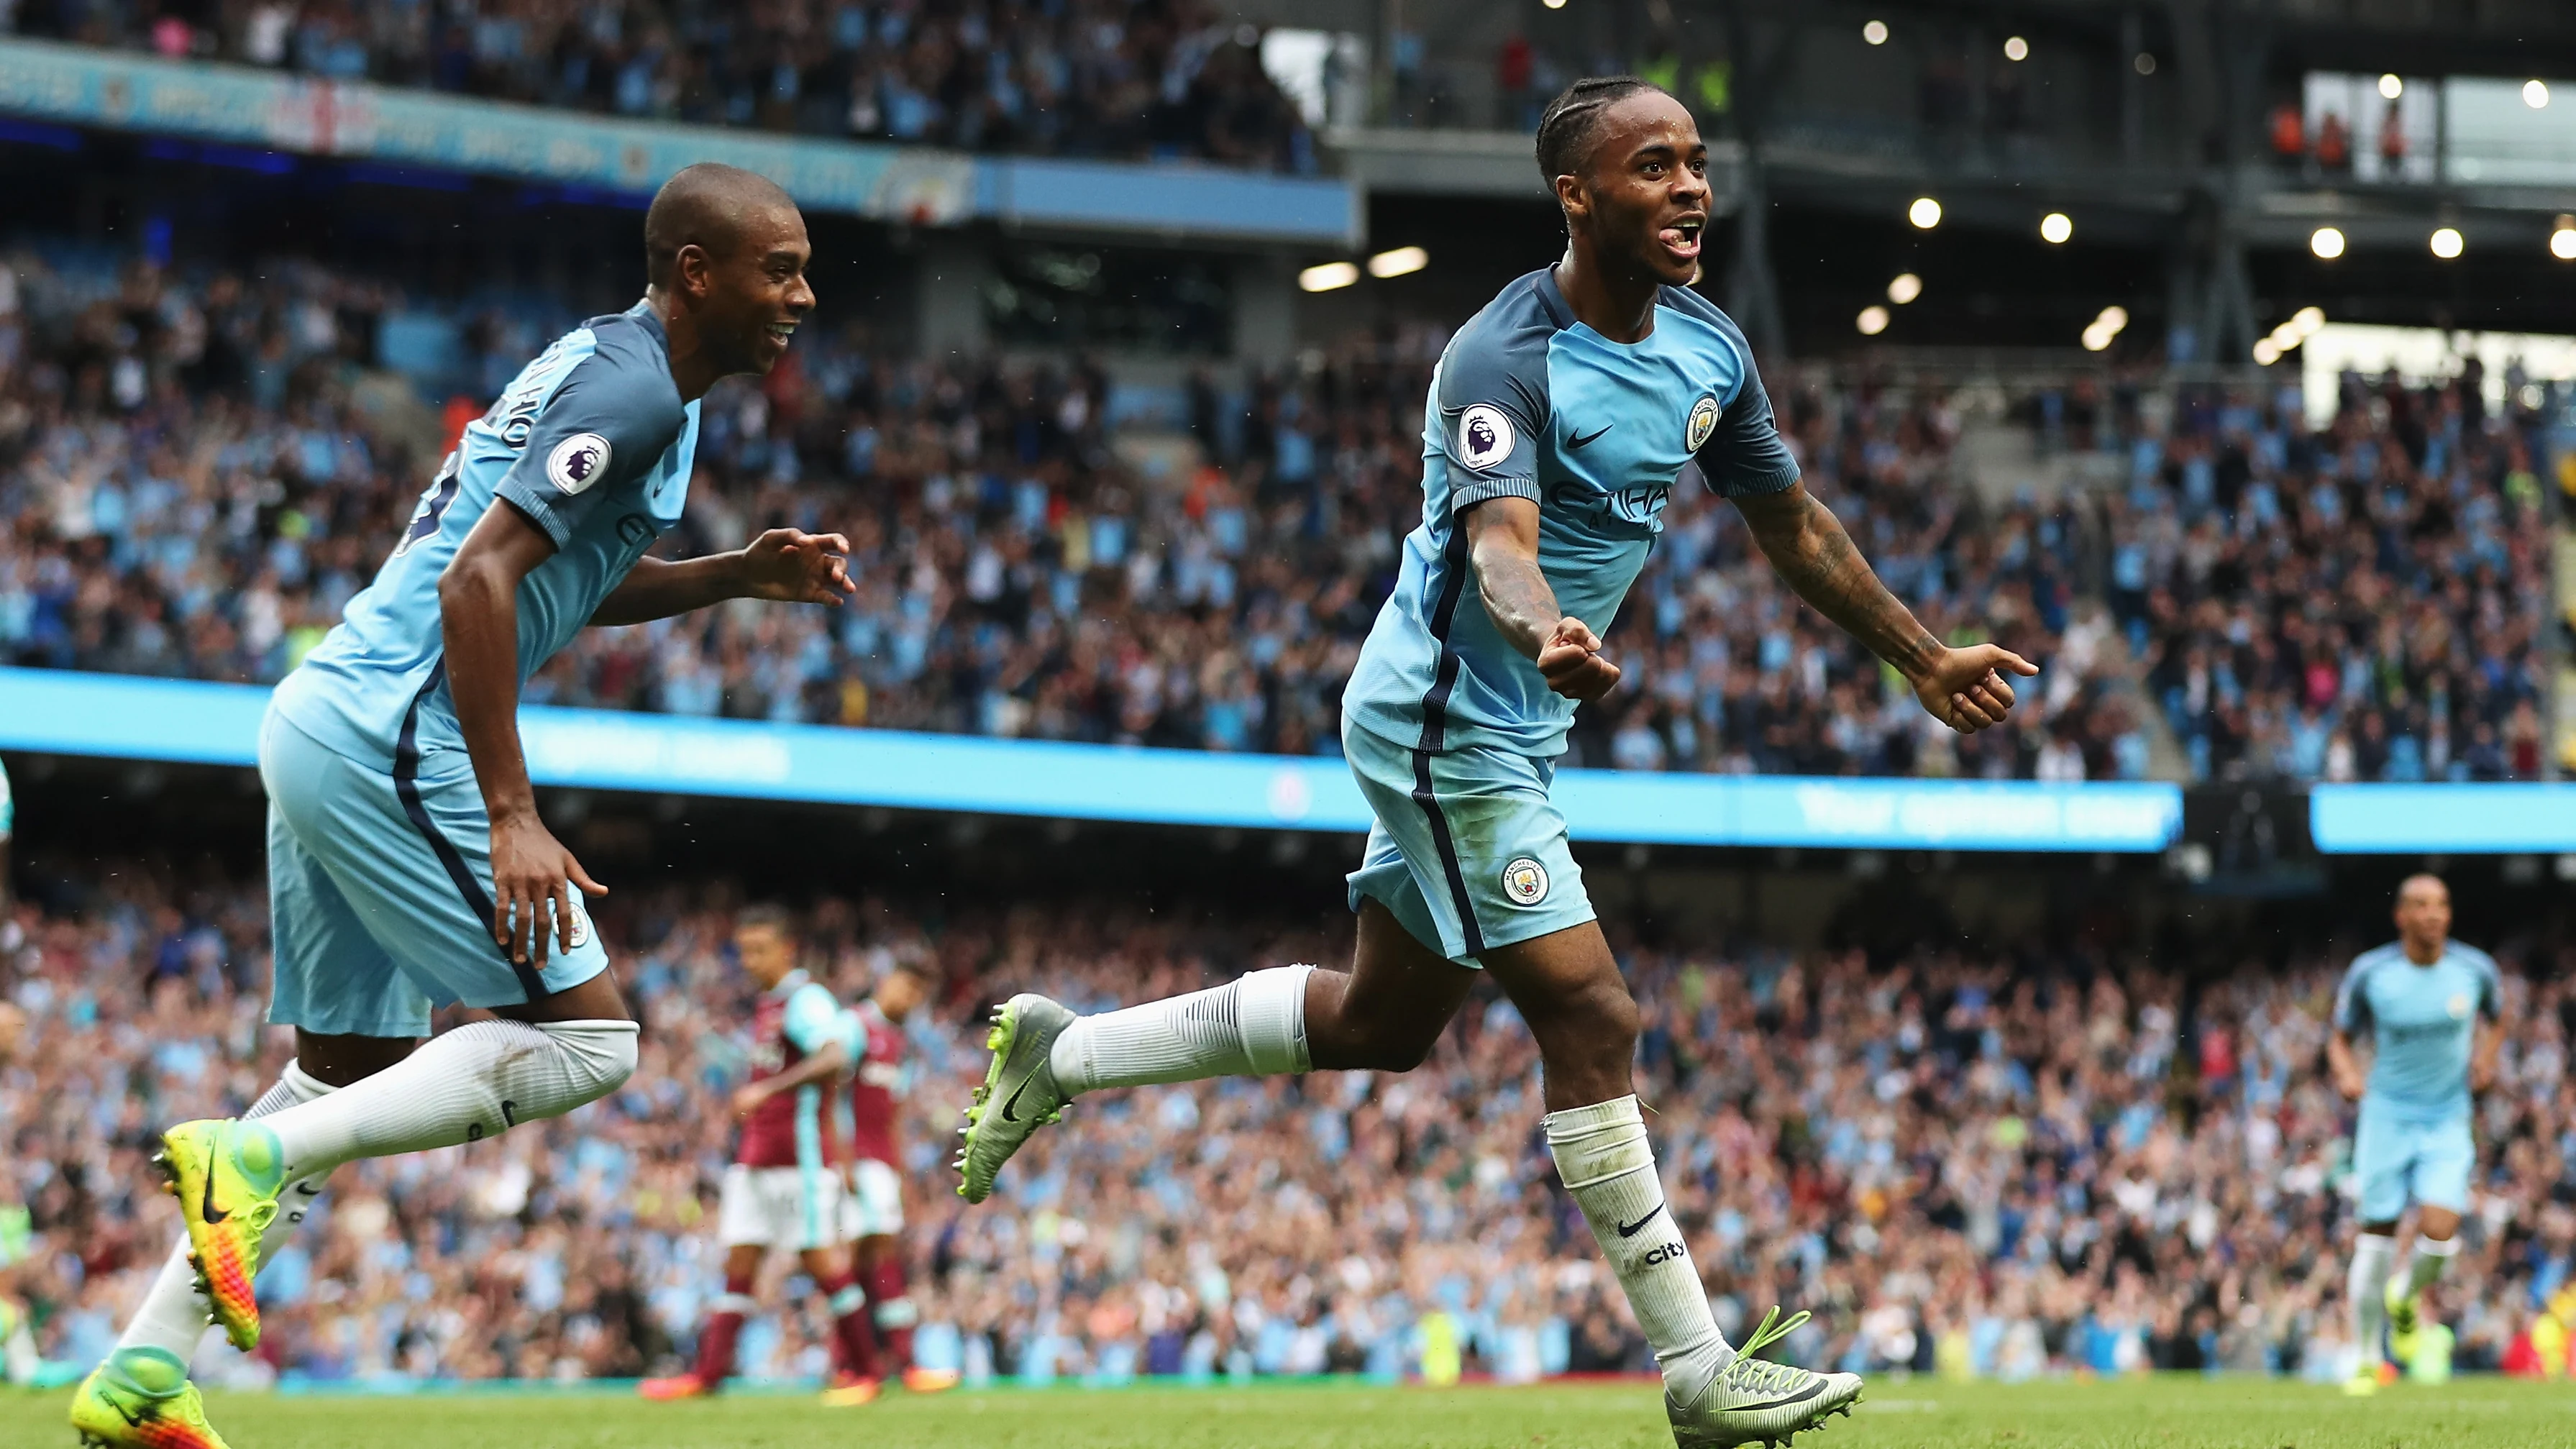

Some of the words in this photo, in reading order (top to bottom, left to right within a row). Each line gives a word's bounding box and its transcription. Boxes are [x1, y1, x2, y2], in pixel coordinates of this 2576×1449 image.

[1691, 400, 1717, 421] MANCHESTER
[1505, 861, 1540, 881] MANCHESTER
[1645, 1240, 1685, 1266] City
